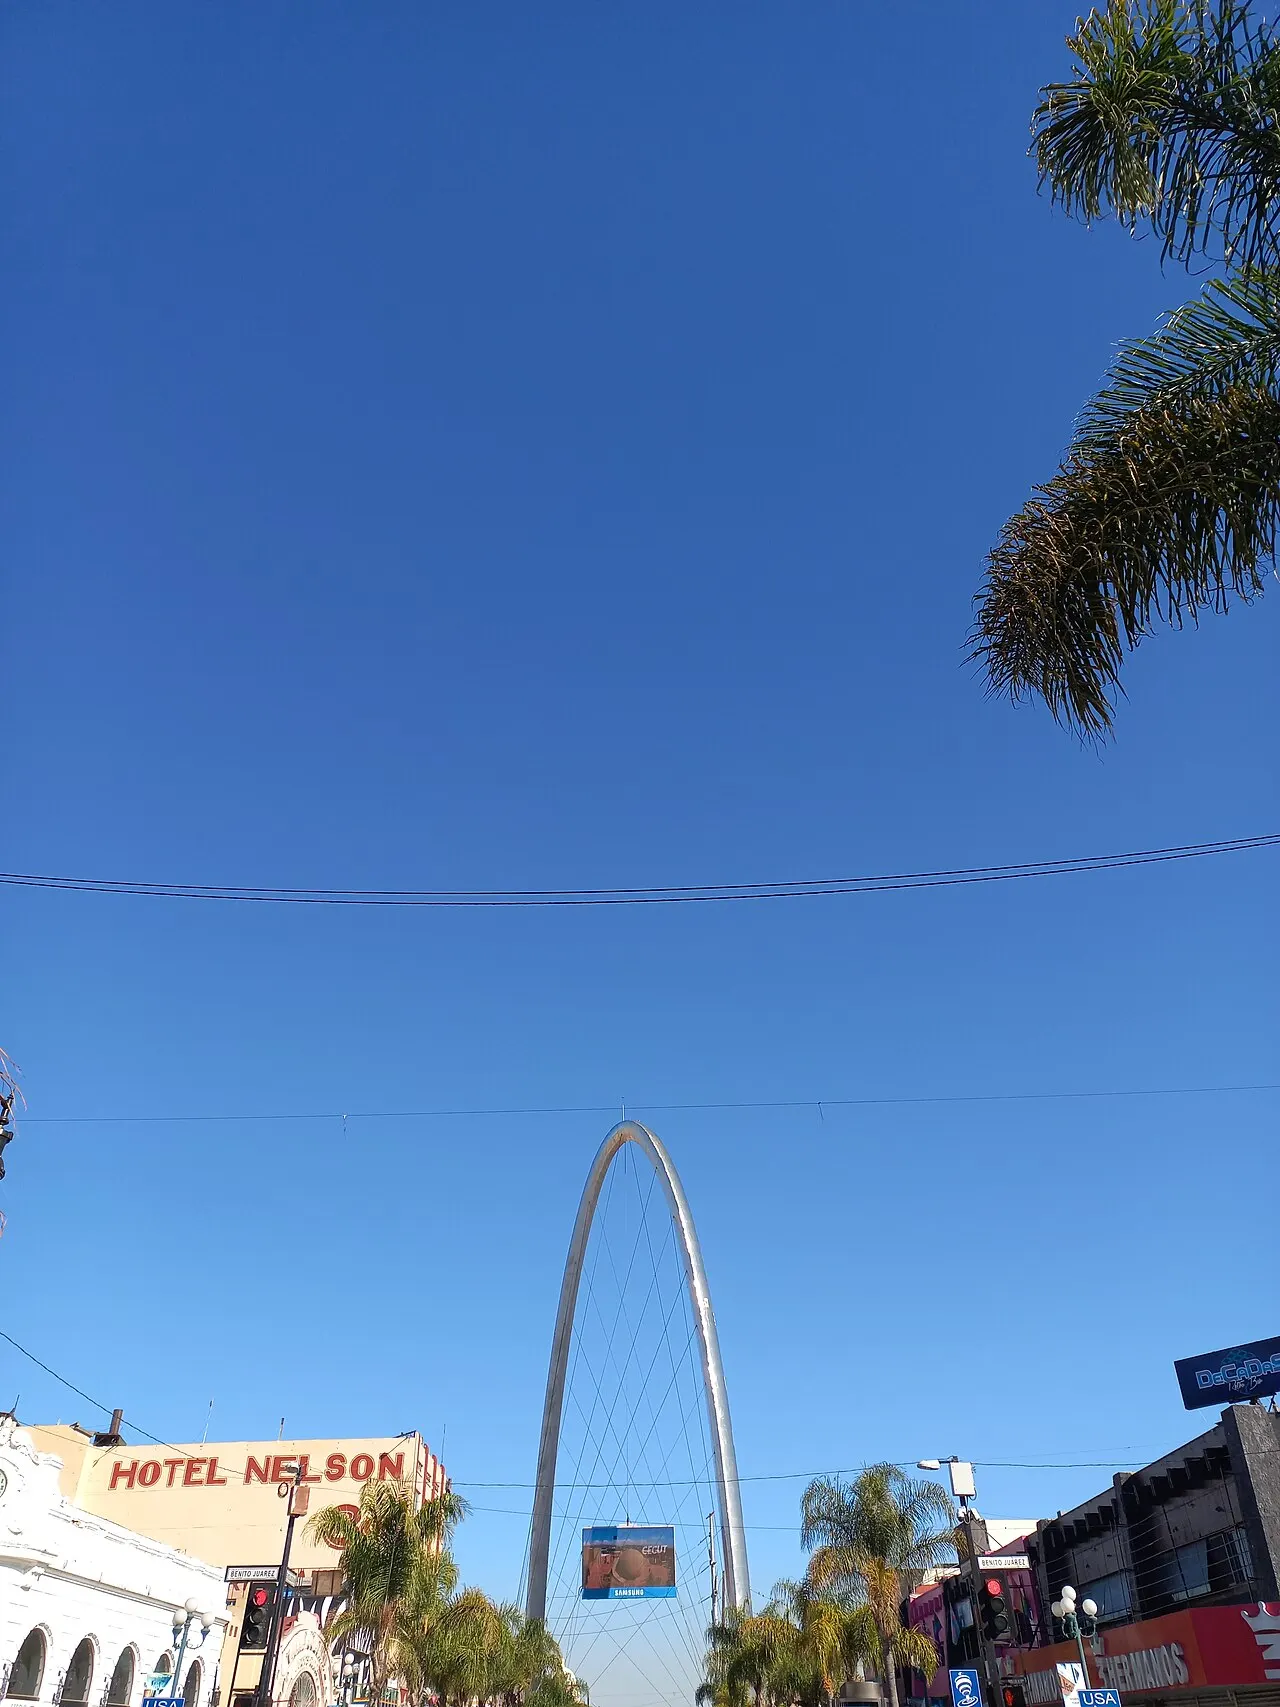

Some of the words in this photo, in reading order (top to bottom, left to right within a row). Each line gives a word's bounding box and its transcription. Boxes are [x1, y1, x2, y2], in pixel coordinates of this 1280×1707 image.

[108, 1457, 227, 1490] HOTEL
[243, 1453, 405, 1485] NELSON
[981, 1559, 1002, 1567] BENITO
[1004, 1558, 1026, 1566] JUAREZ
[230, 1570, 252, 1578] BENITO
[614, 1588, 644, 1597] SAMSUNG
[1082, 1692, 1117, 1705] USA
